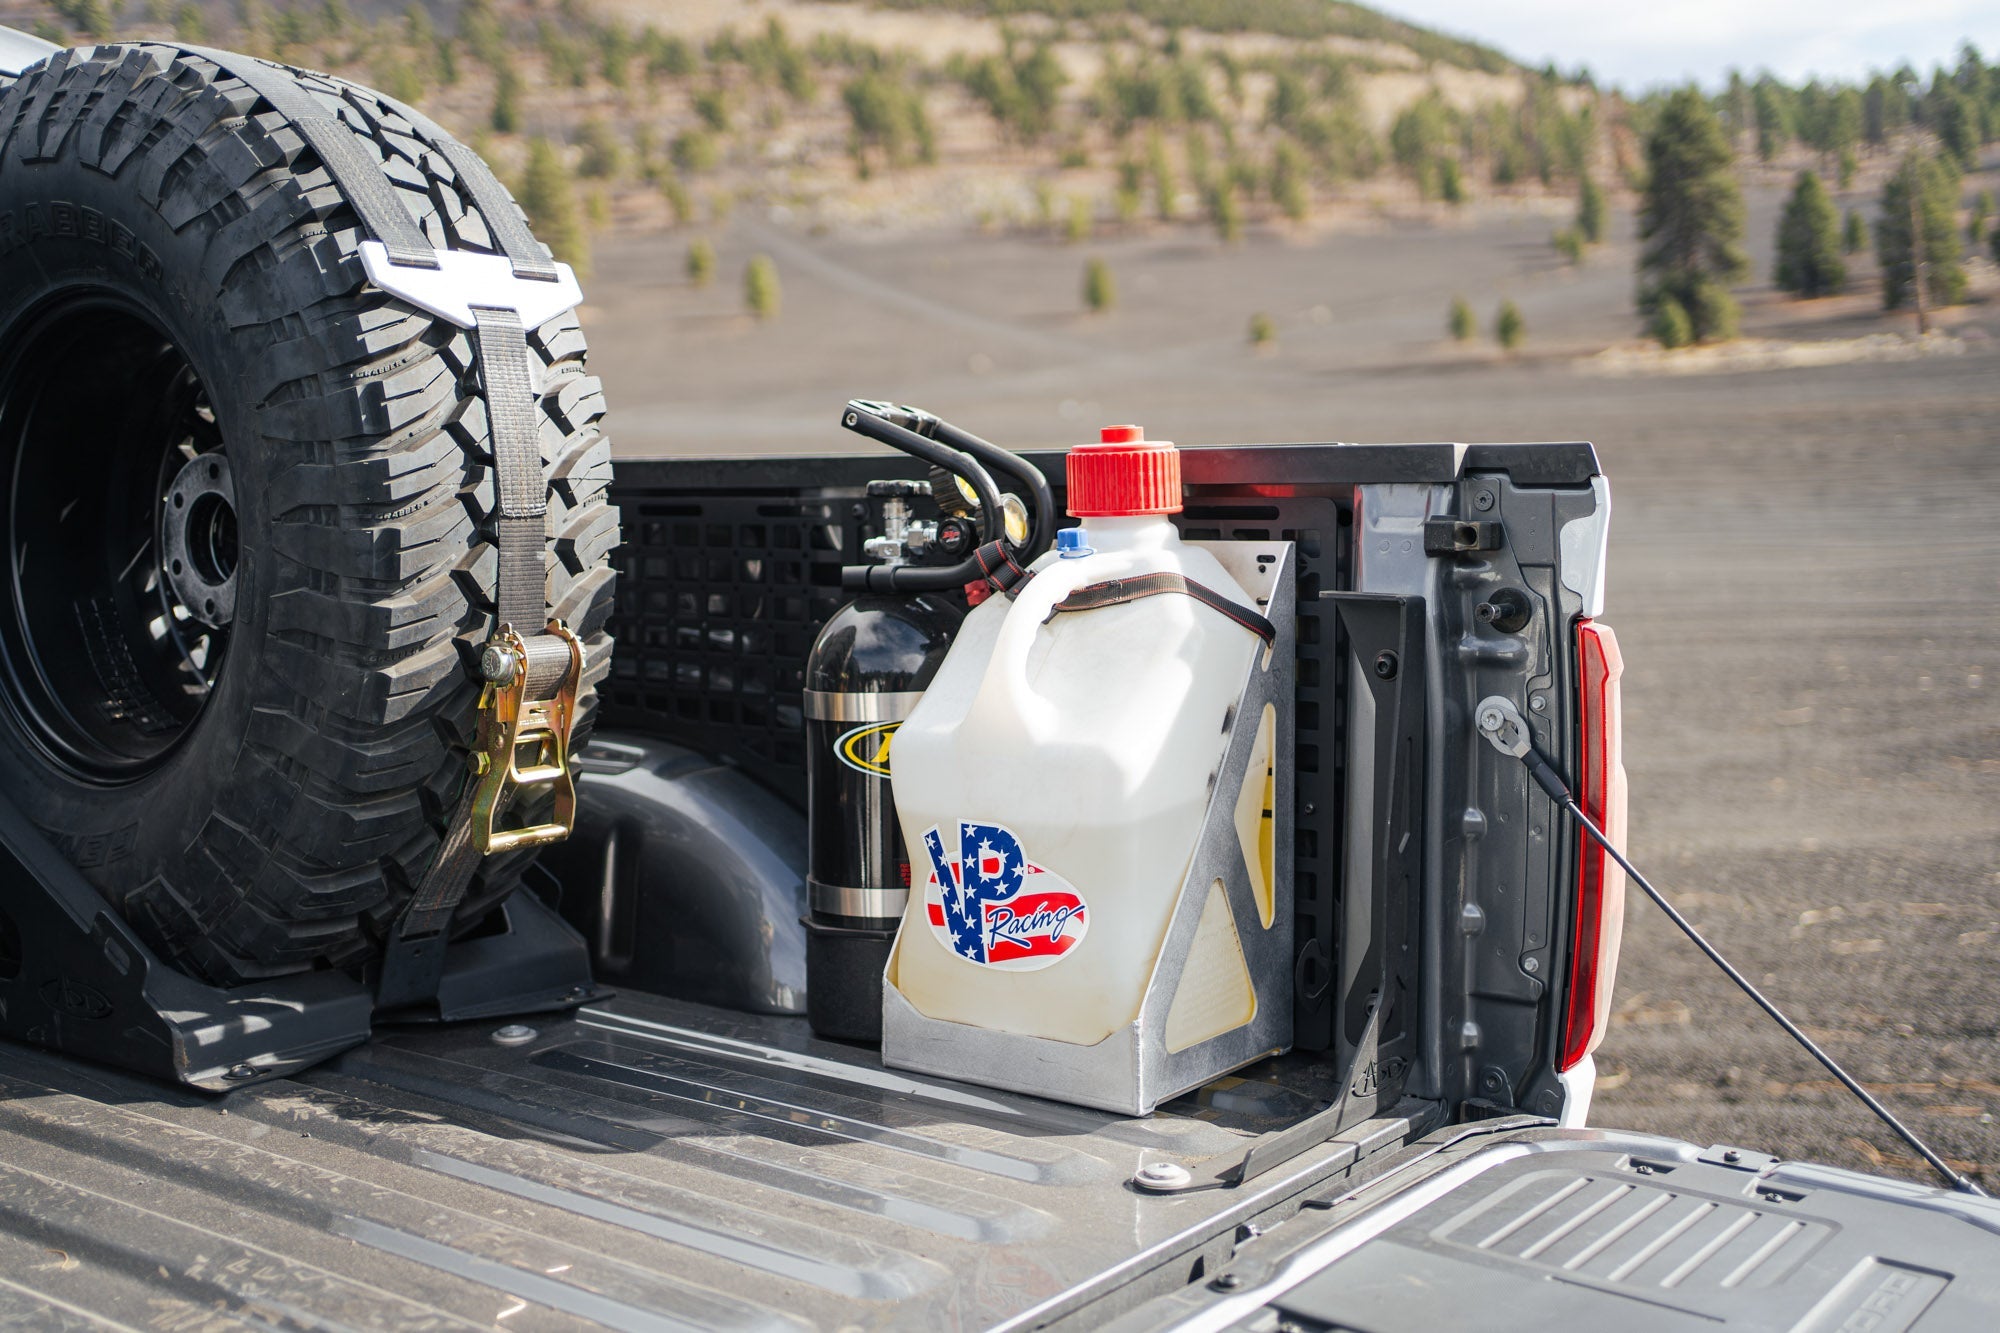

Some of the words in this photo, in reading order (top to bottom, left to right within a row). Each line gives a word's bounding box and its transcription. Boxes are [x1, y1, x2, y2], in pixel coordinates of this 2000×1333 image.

[924, 823, 1024, 964] VP
[988, 902, 1086, 949] Racing
[1836, 1270, 1922, 1333] ORD
